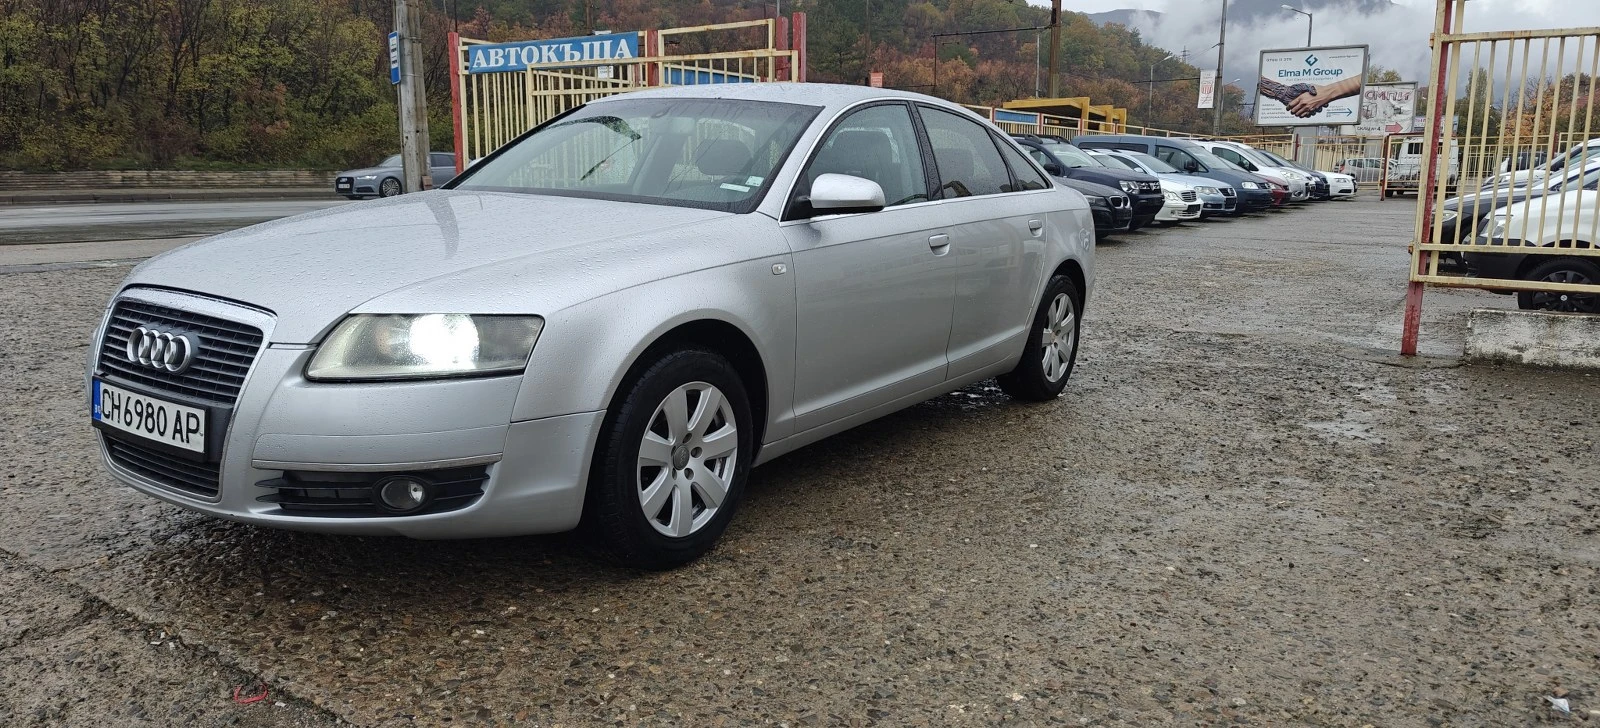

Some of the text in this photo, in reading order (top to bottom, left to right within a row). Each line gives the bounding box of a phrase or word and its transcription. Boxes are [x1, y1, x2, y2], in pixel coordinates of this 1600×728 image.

[1278, 68, 1343, 78] Elma M Group
[171, 409, 200, 444] AP
